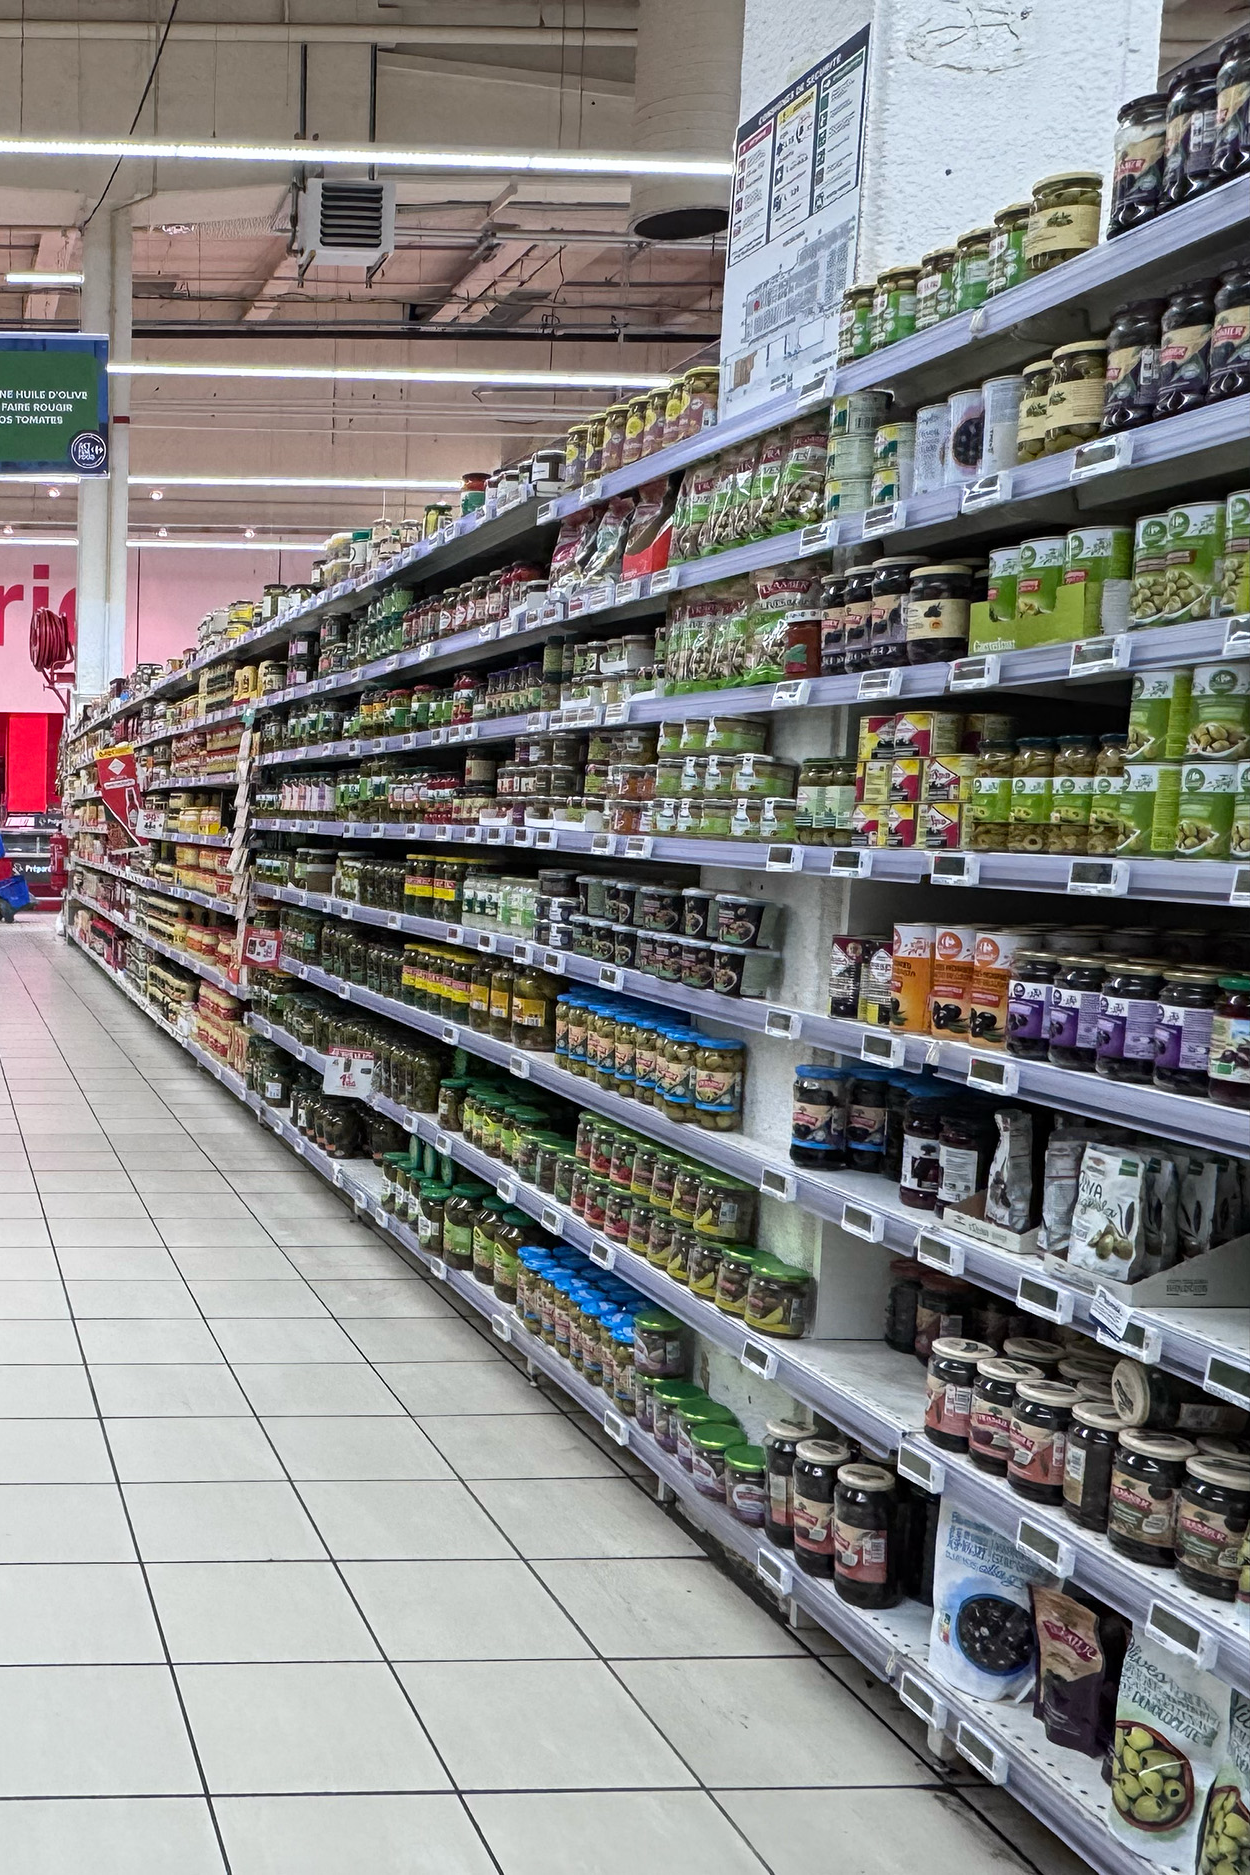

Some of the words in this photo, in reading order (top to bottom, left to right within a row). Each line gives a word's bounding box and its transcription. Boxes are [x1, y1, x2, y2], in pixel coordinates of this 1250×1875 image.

[15, 389, 46, 400] HUILE
[48, 390, 88, 400] D'OLIVE
[1, 402, 31, 412] FAIRE
[33, 403, 73, 412] ROUGIR
[15, 415, 63, 425] TOMATES
